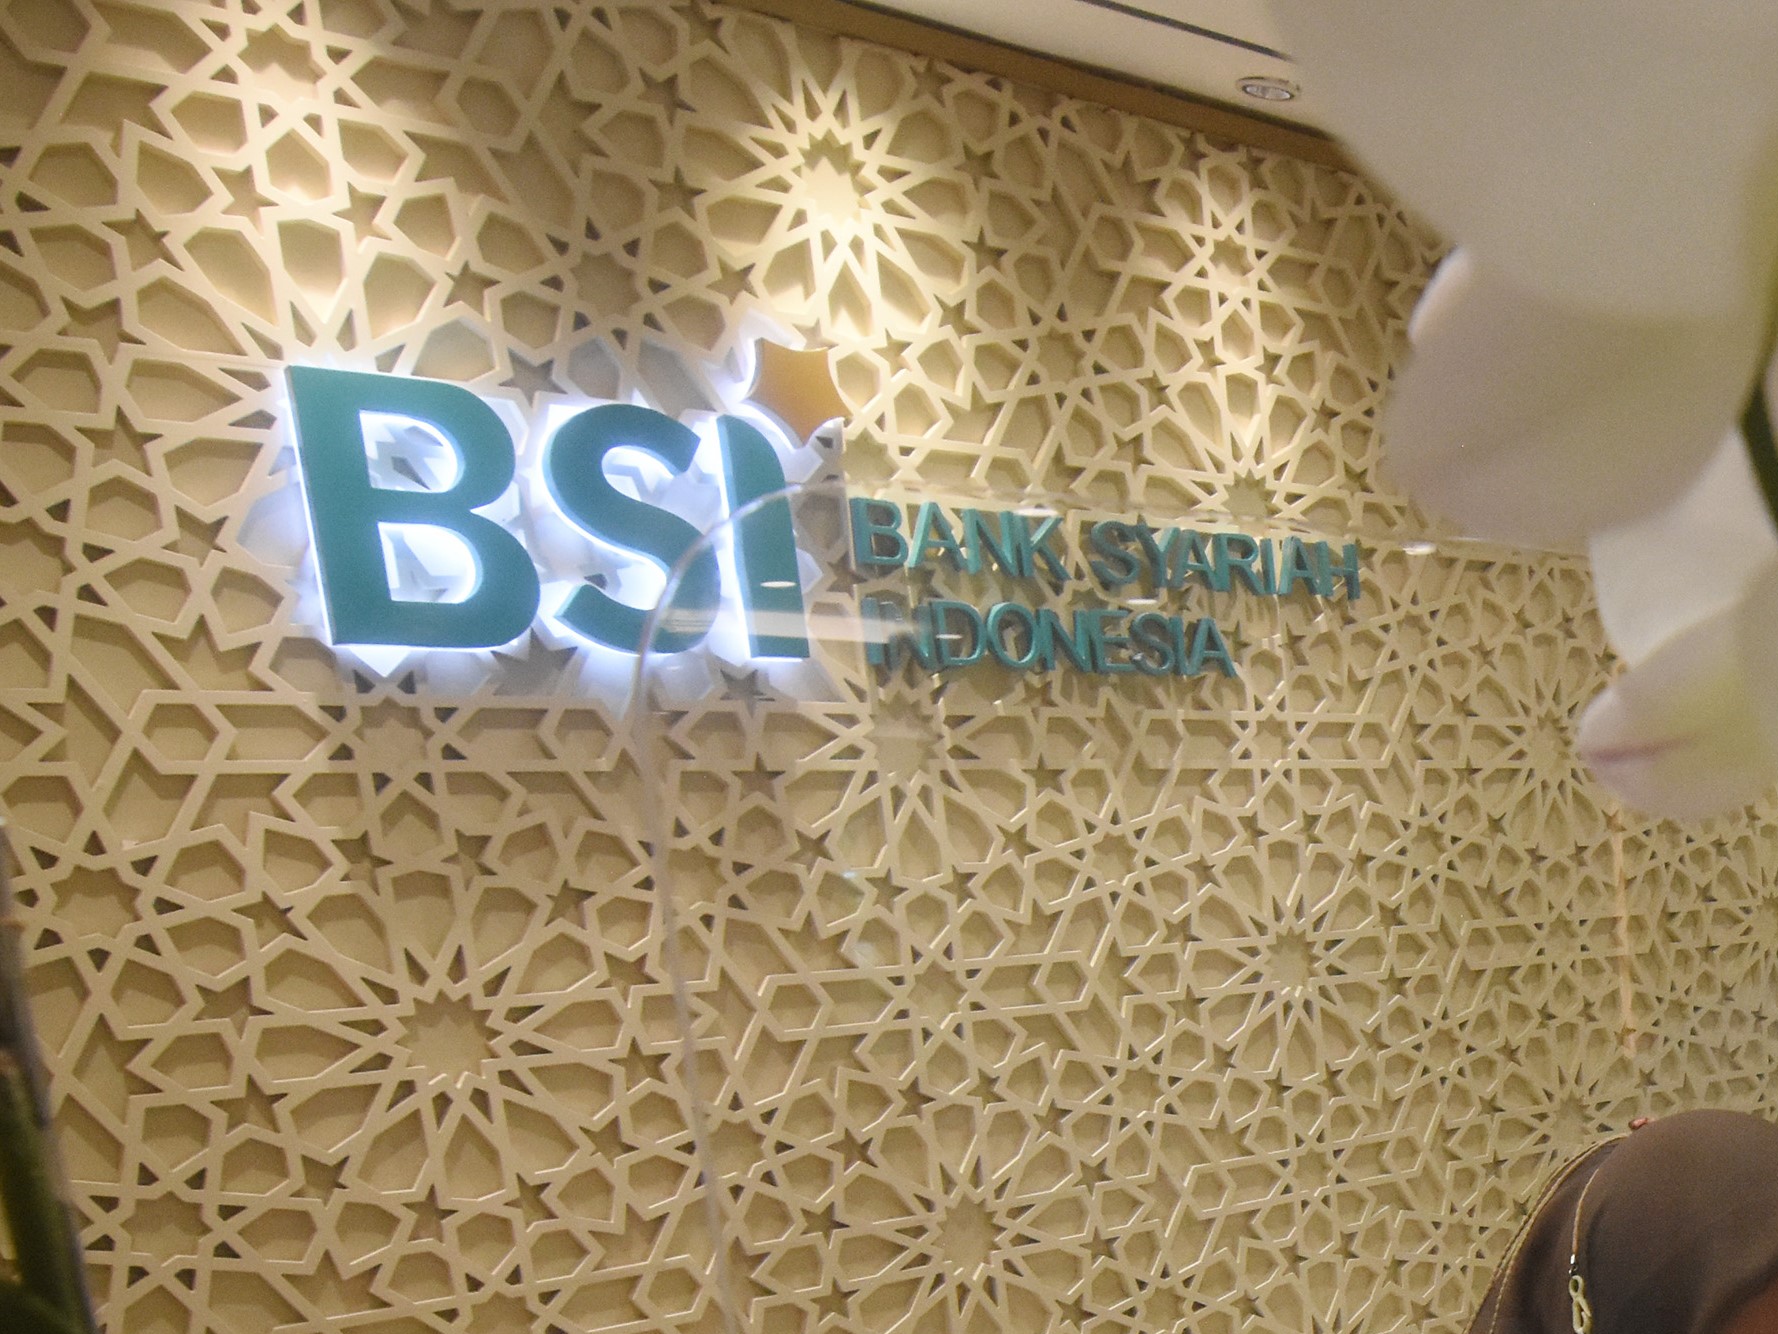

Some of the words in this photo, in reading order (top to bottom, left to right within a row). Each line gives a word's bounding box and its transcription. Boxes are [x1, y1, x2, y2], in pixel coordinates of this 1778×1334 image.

[286, 362, 811, 660] BSI
[850, 497, 1072, 583] BANK
[1089, 514, 1361, 600] SYARIAH
[862, 596, 1237, 678] INDONESIA
